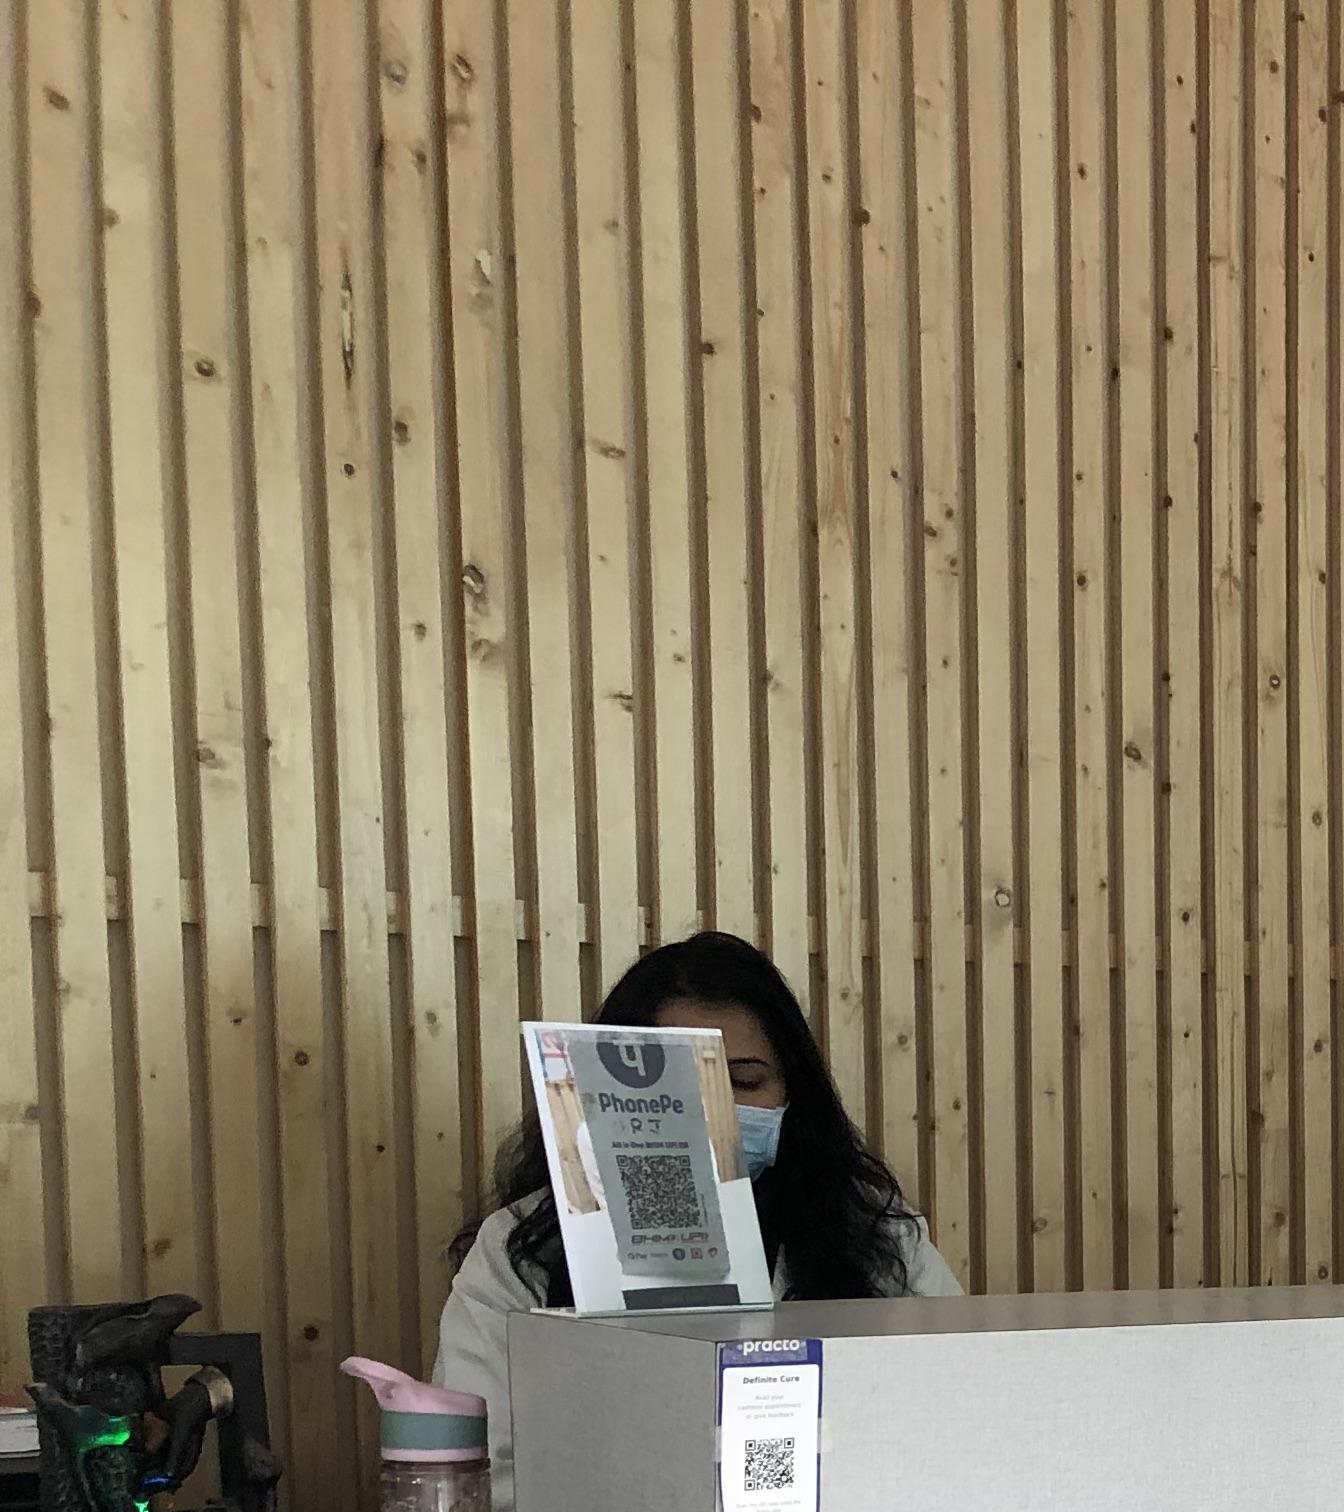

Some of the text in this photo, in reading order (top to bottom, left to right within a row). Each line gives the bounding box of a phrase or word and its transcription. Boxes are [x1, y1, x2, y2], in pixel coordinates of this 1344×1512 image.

[598, 1092, 685, 1114] PhonePe
[743, 1338, 800, 1356] practo
[743, 1375, 800, 1385] Definite Cure
